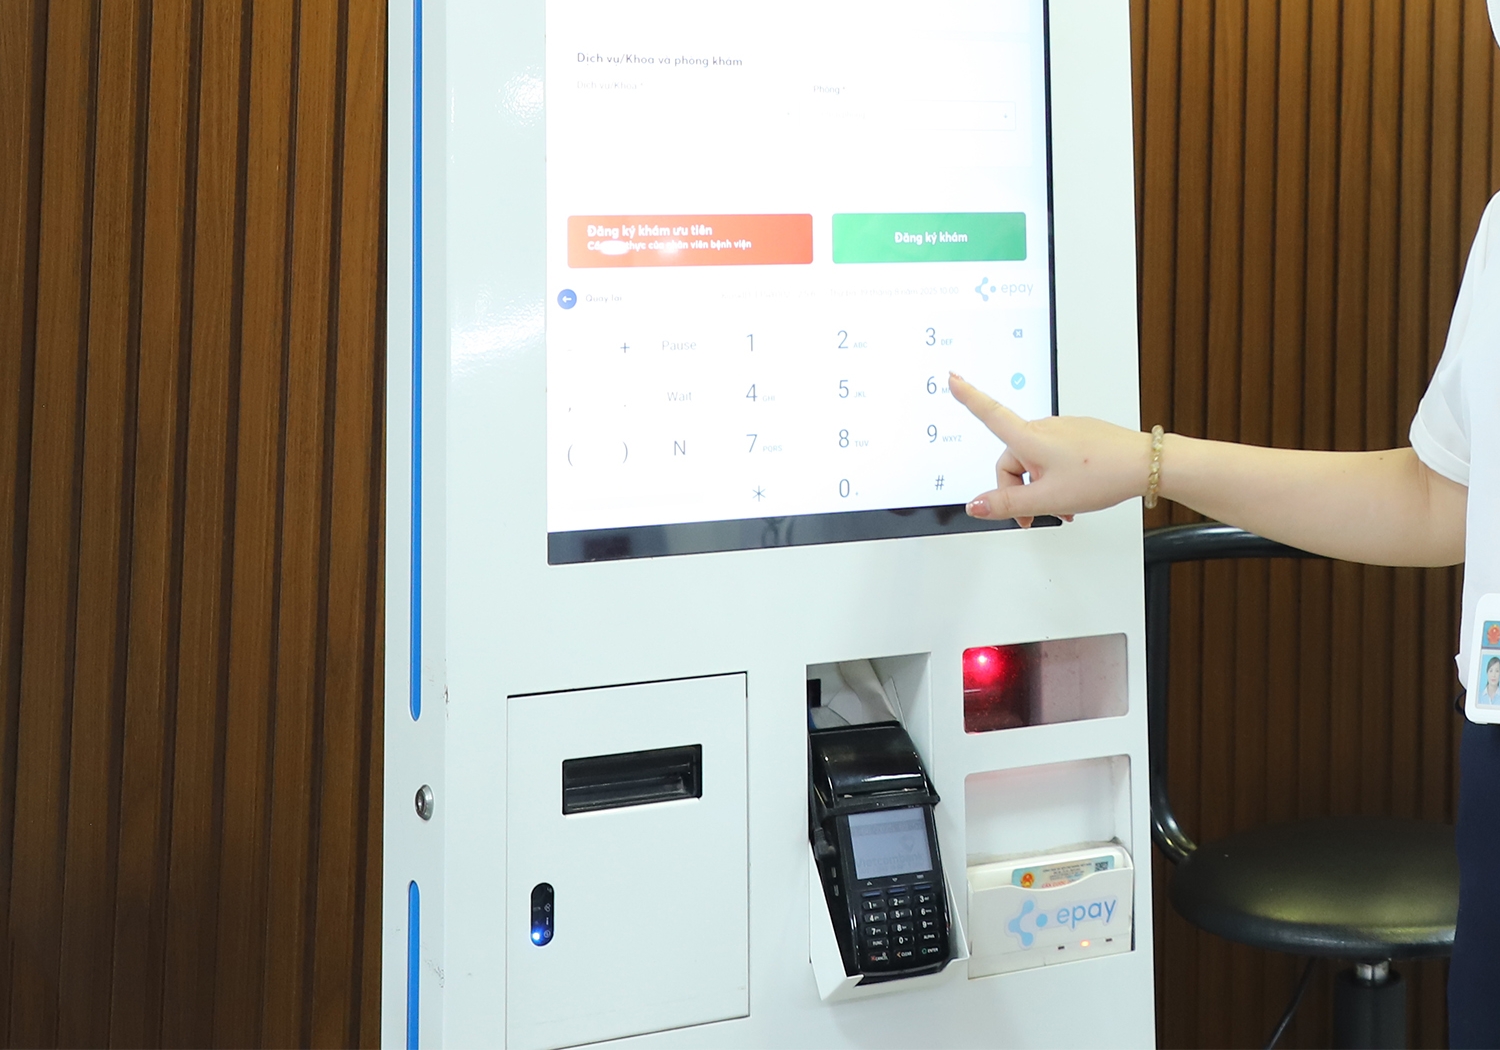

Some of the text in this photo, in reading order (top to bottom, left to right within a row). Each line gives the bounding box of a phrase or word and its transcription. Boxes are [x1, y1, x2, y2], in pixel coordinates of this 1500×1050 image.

[577, 52, 743, 67] Dịch vụ/Khoa và phòng khám
[587, 224, 712, 240] Đăng ký khám ưu tiên
[894, 231, 968, 245] Đăng ký khám
[690, 240, 708, 249] viên
[711, 240, 732, 250] bệnh
[734, 239, 752, 250] viện
[1001, 283, 1034, 296] epay
[661, 340, 696, 351] Pause
[746, 334, 754, 352] 1
[837, 330, 849, 349] 2
[925, 327, 936, 346] 3
[667, 391, 692, 402] Wait
[746, 383, 758, 402] 4
[838, 379, 849, 398] 5
[926, 376, 937, 395] 6
[674, 440, 686, 455] N
[746, 434, 758, 453] 7
[838, 429, 850, 448] 8
[927, 424, 938, 443] 9
[839, 478, 850, 498] 0
[1057, 900, 1116, 929] epay
